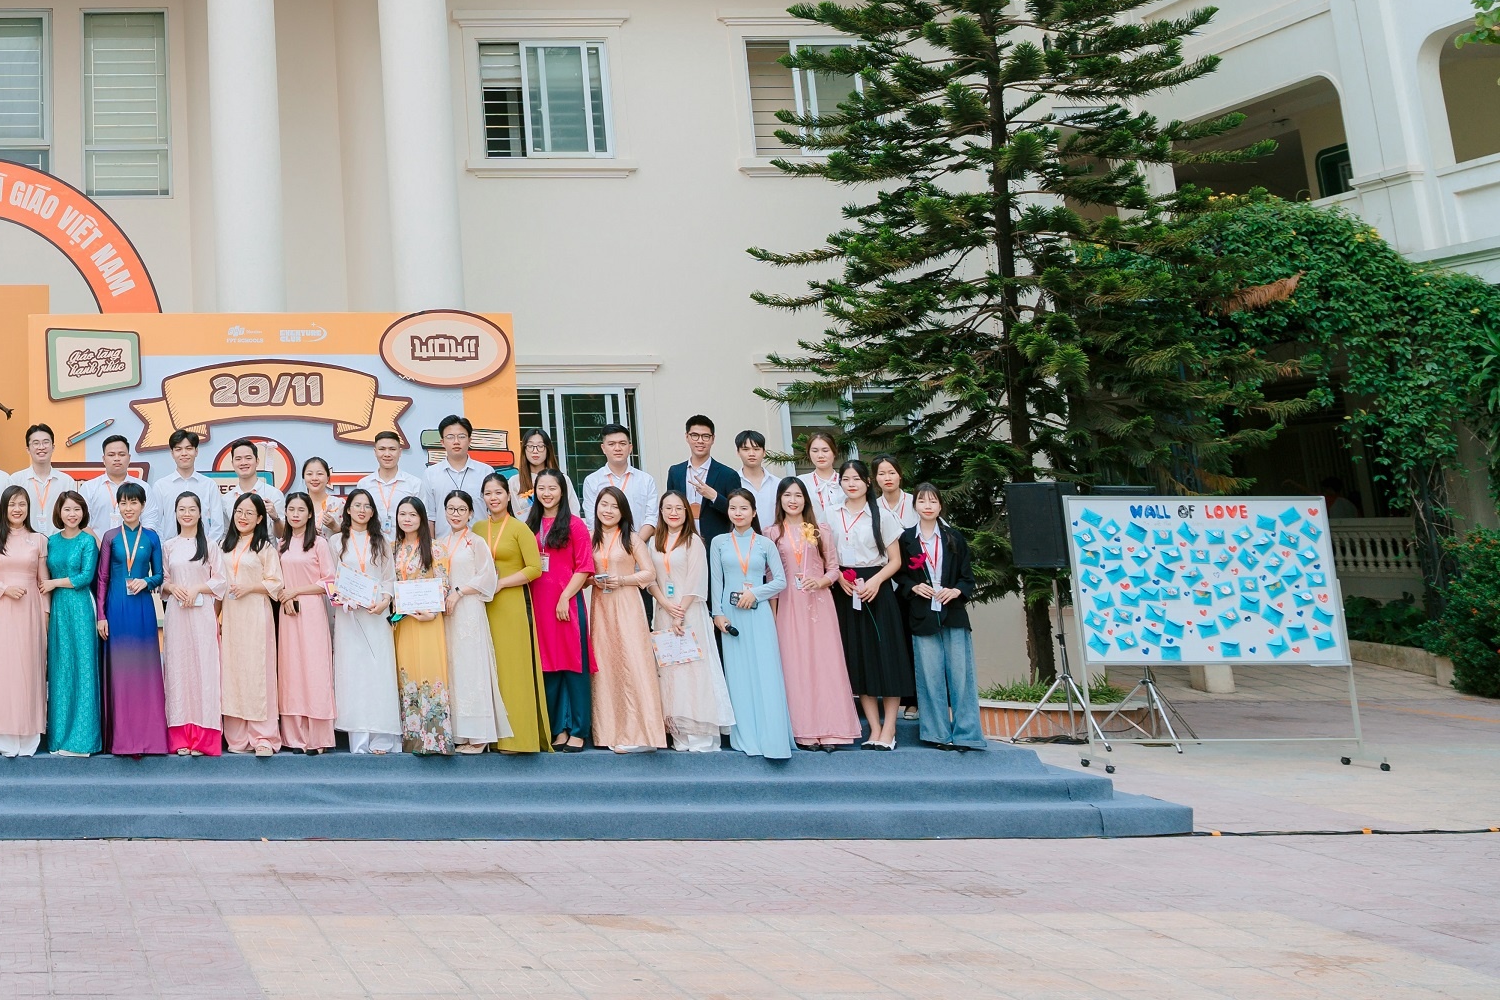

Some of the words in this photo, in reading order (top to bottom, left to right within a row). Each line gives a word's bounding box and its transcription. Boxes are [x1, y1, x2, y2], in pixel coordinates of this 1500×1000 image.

[57, 205, 103, 249] VIỆT
[90, 243, 136, 297] NAM
[211, 374, 322, 406] 20/11
[1129, 504, 1171, 519] WALL
[1177, 504, 1195, 519] OF
[1204, 504, 1248, 519] LOVE
